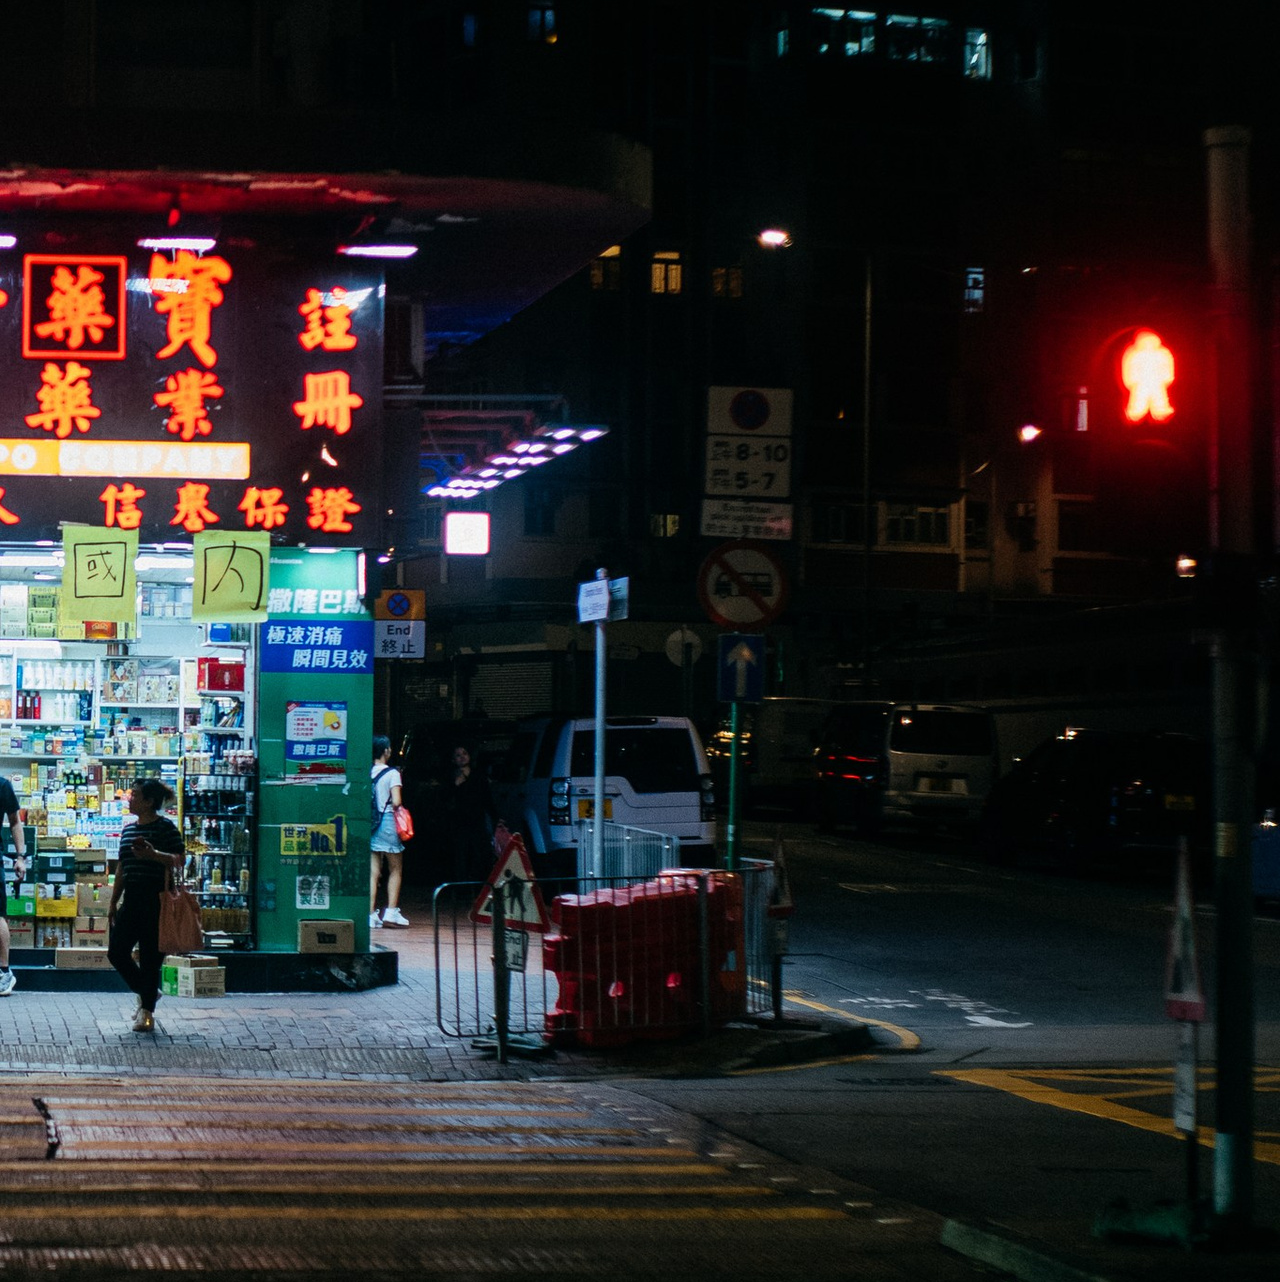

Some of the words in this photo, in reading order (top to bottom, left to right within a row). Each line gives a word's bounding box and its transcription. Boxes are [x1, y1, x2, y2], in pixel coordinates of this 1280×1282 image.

[293, 286, 364, 435] 註冊
[60, 445, 243, 474] COMPANY
[387, 625, 411, 636] End
[382, 639, 416, 654] 終止
